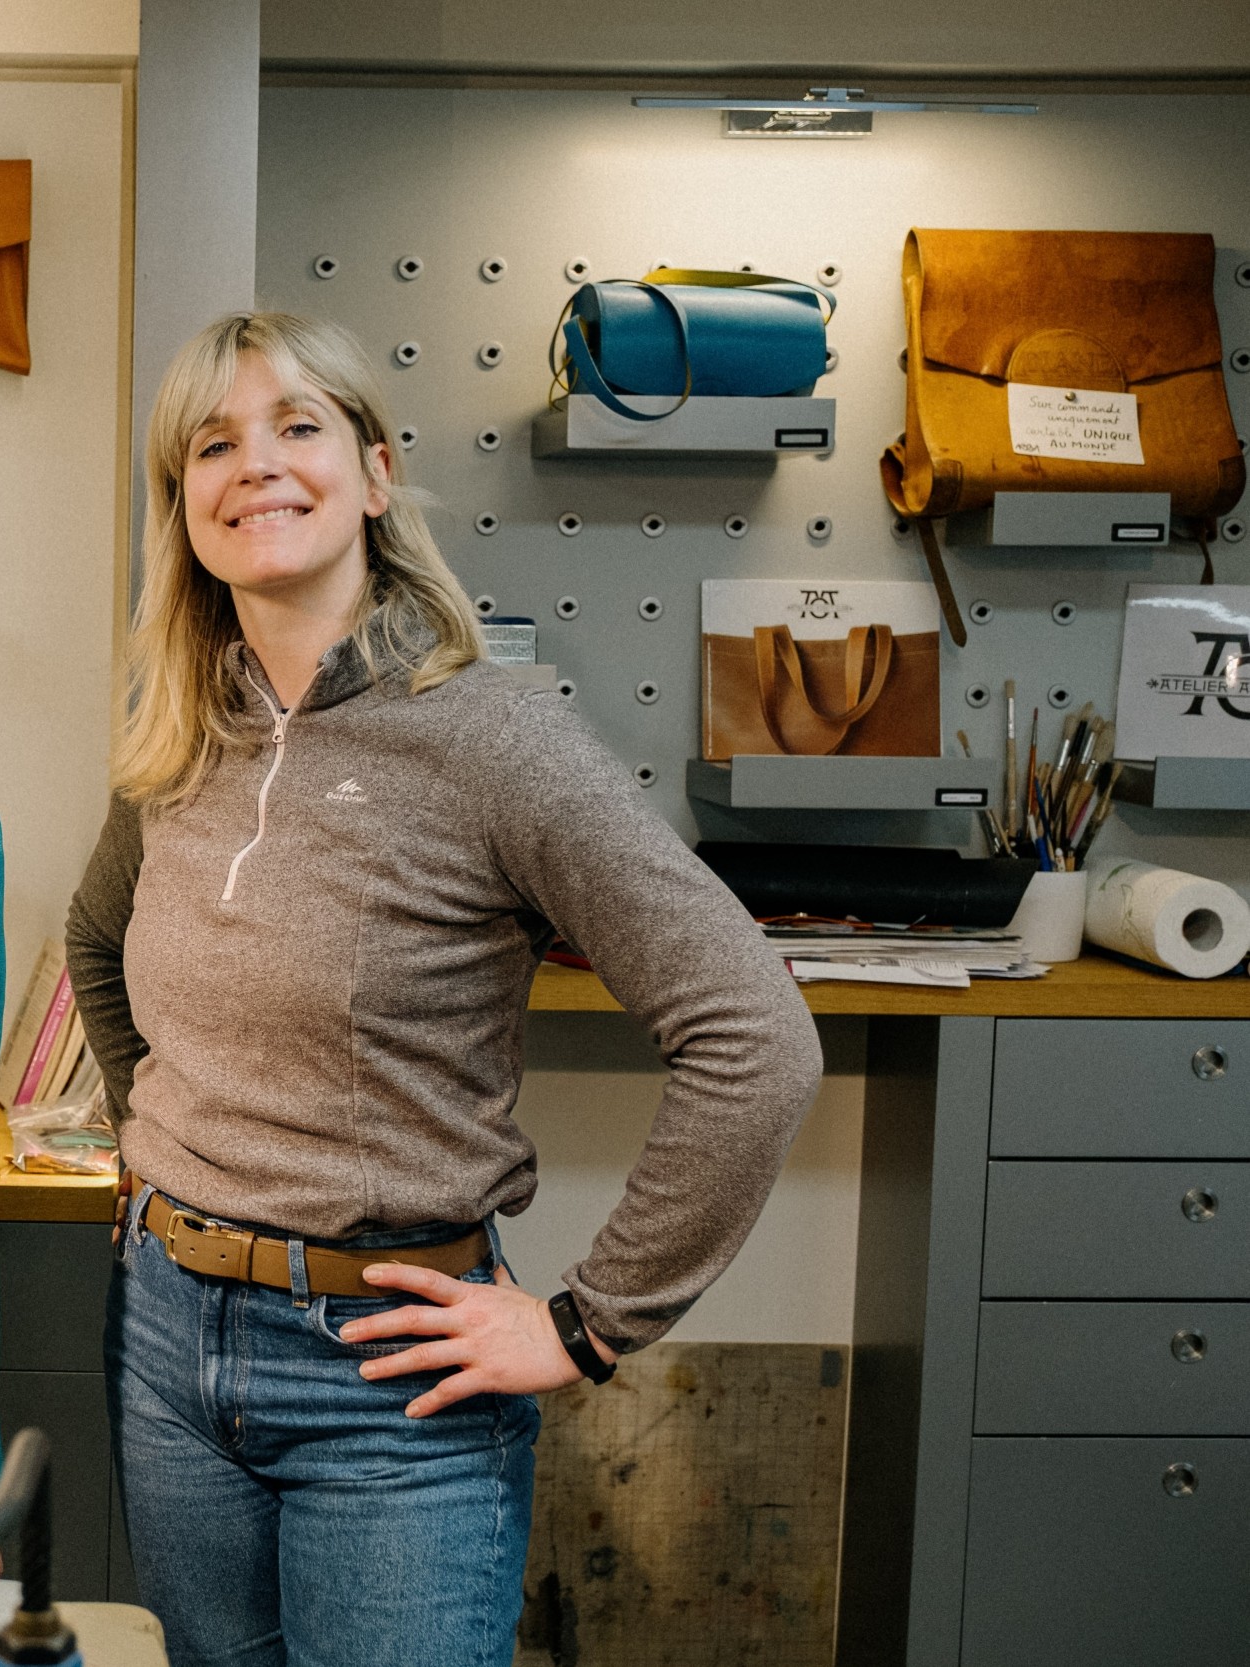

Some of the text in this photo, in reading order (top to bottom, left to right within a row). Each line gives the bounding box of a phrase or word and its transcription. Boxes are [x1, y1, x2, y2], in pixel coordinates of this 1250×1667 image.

[1029, 396, 1121, 414] Sur commande
[1047, 415, 1120, 428] uniquement
[1050, 439, 1117, 451] AU MONDE
[1160, 678, 1227, 693] ATELIER
